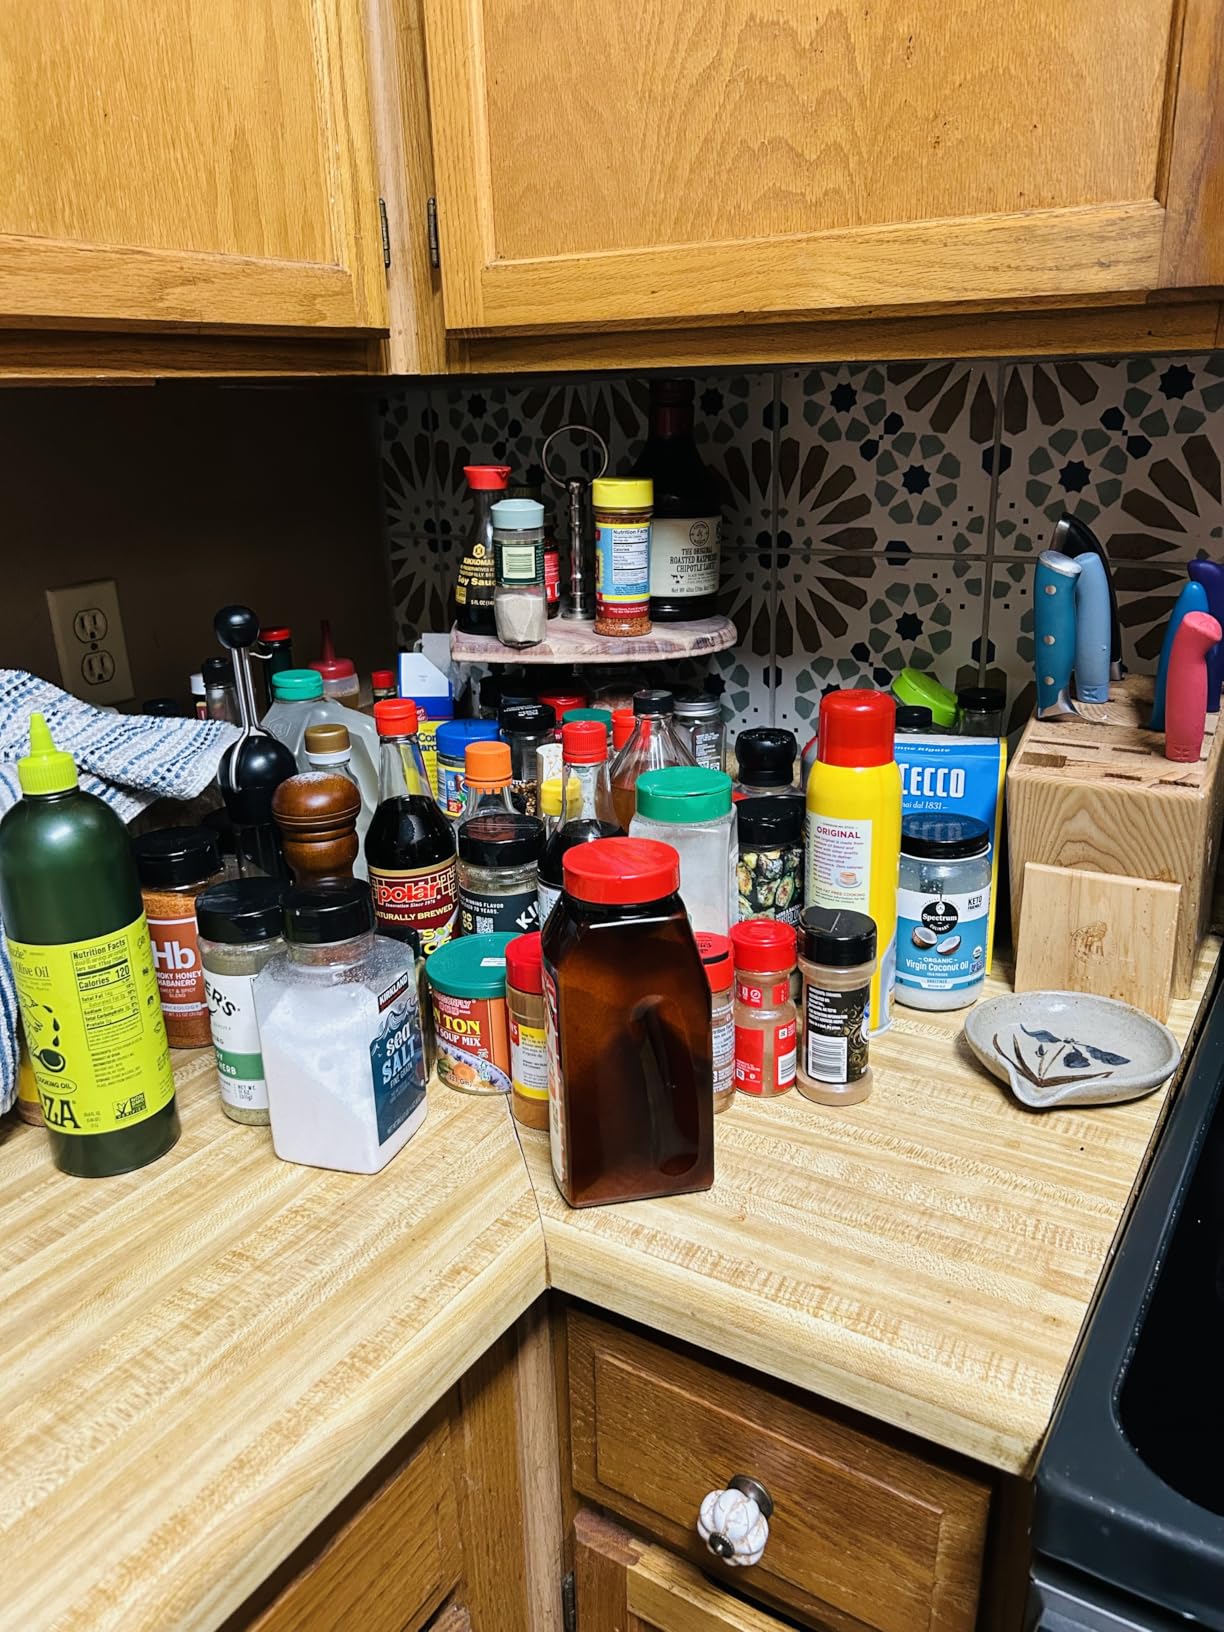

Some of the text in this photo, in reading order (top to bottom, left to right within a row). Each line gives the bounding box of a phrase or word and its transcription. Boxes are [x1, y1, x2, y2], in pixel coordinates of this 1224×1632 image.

[669, 556, 696, 565] ROASTED
[677, 564, 703, 573] CHIPOTLE
[925, 801, 942, 810] 1831
[816, 826, 861, 839] ORIGINAL
[968, 896, 982, 905] KETO
[417, 904, 453, 919] BREWED
[922, 913, 957, 922] Spectrum
[73, 938, 126, 960] Nutrition Facts
[150, 941, 196, 970] Hb
[34, 965, 50, 978] Oil
[906, 959, 969, 972] Virgin Coconut Oil
[79, 964, 130, 989] Calories 120
[175, 969, 202, 980] HONEY
[379, 974, 408, 1005] KIRKLAND
[443, 1013, 481, 1035] TON
[386, 1021, 411, 1057] sea
[440, 1029, 482, 1047] SOUP MIX
[381, 1034, 416, 1085] SALT
